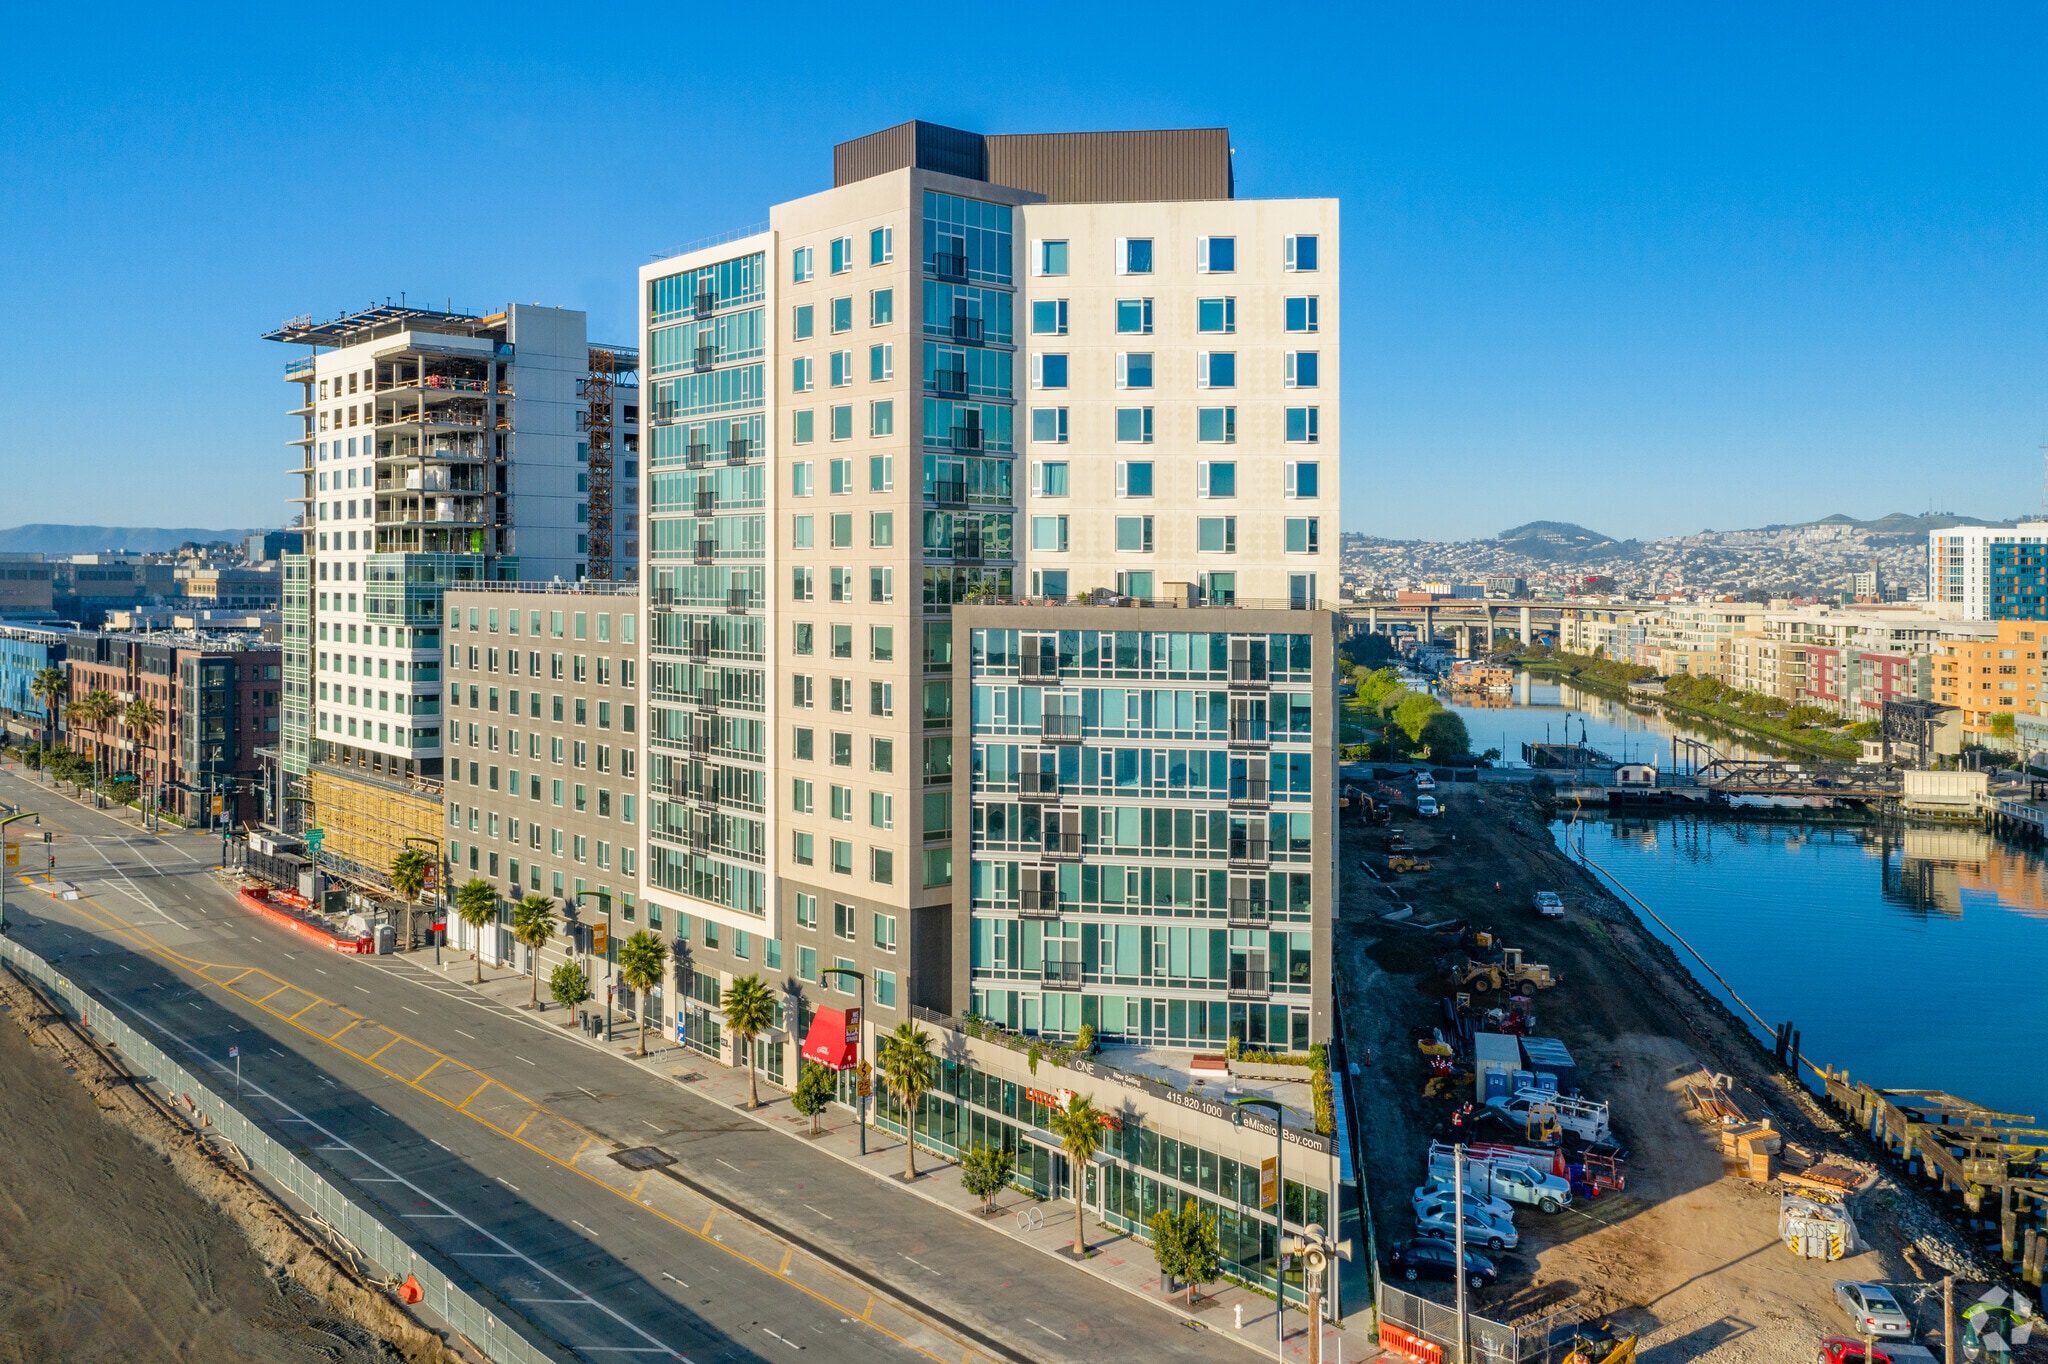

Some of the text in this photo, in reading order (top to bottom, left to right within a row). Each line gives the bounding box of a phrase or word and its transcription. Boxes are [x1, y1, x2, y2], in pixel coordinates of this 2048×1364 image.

[1075, 1060, 1095, 1075] ONE
[859, 1082, 869, 1091] 25
[1112, 1071, 1141, 1087] Now Selling
[1166, 1091, 1323, 1151] 415.820.1000 OeMissioBay.com
